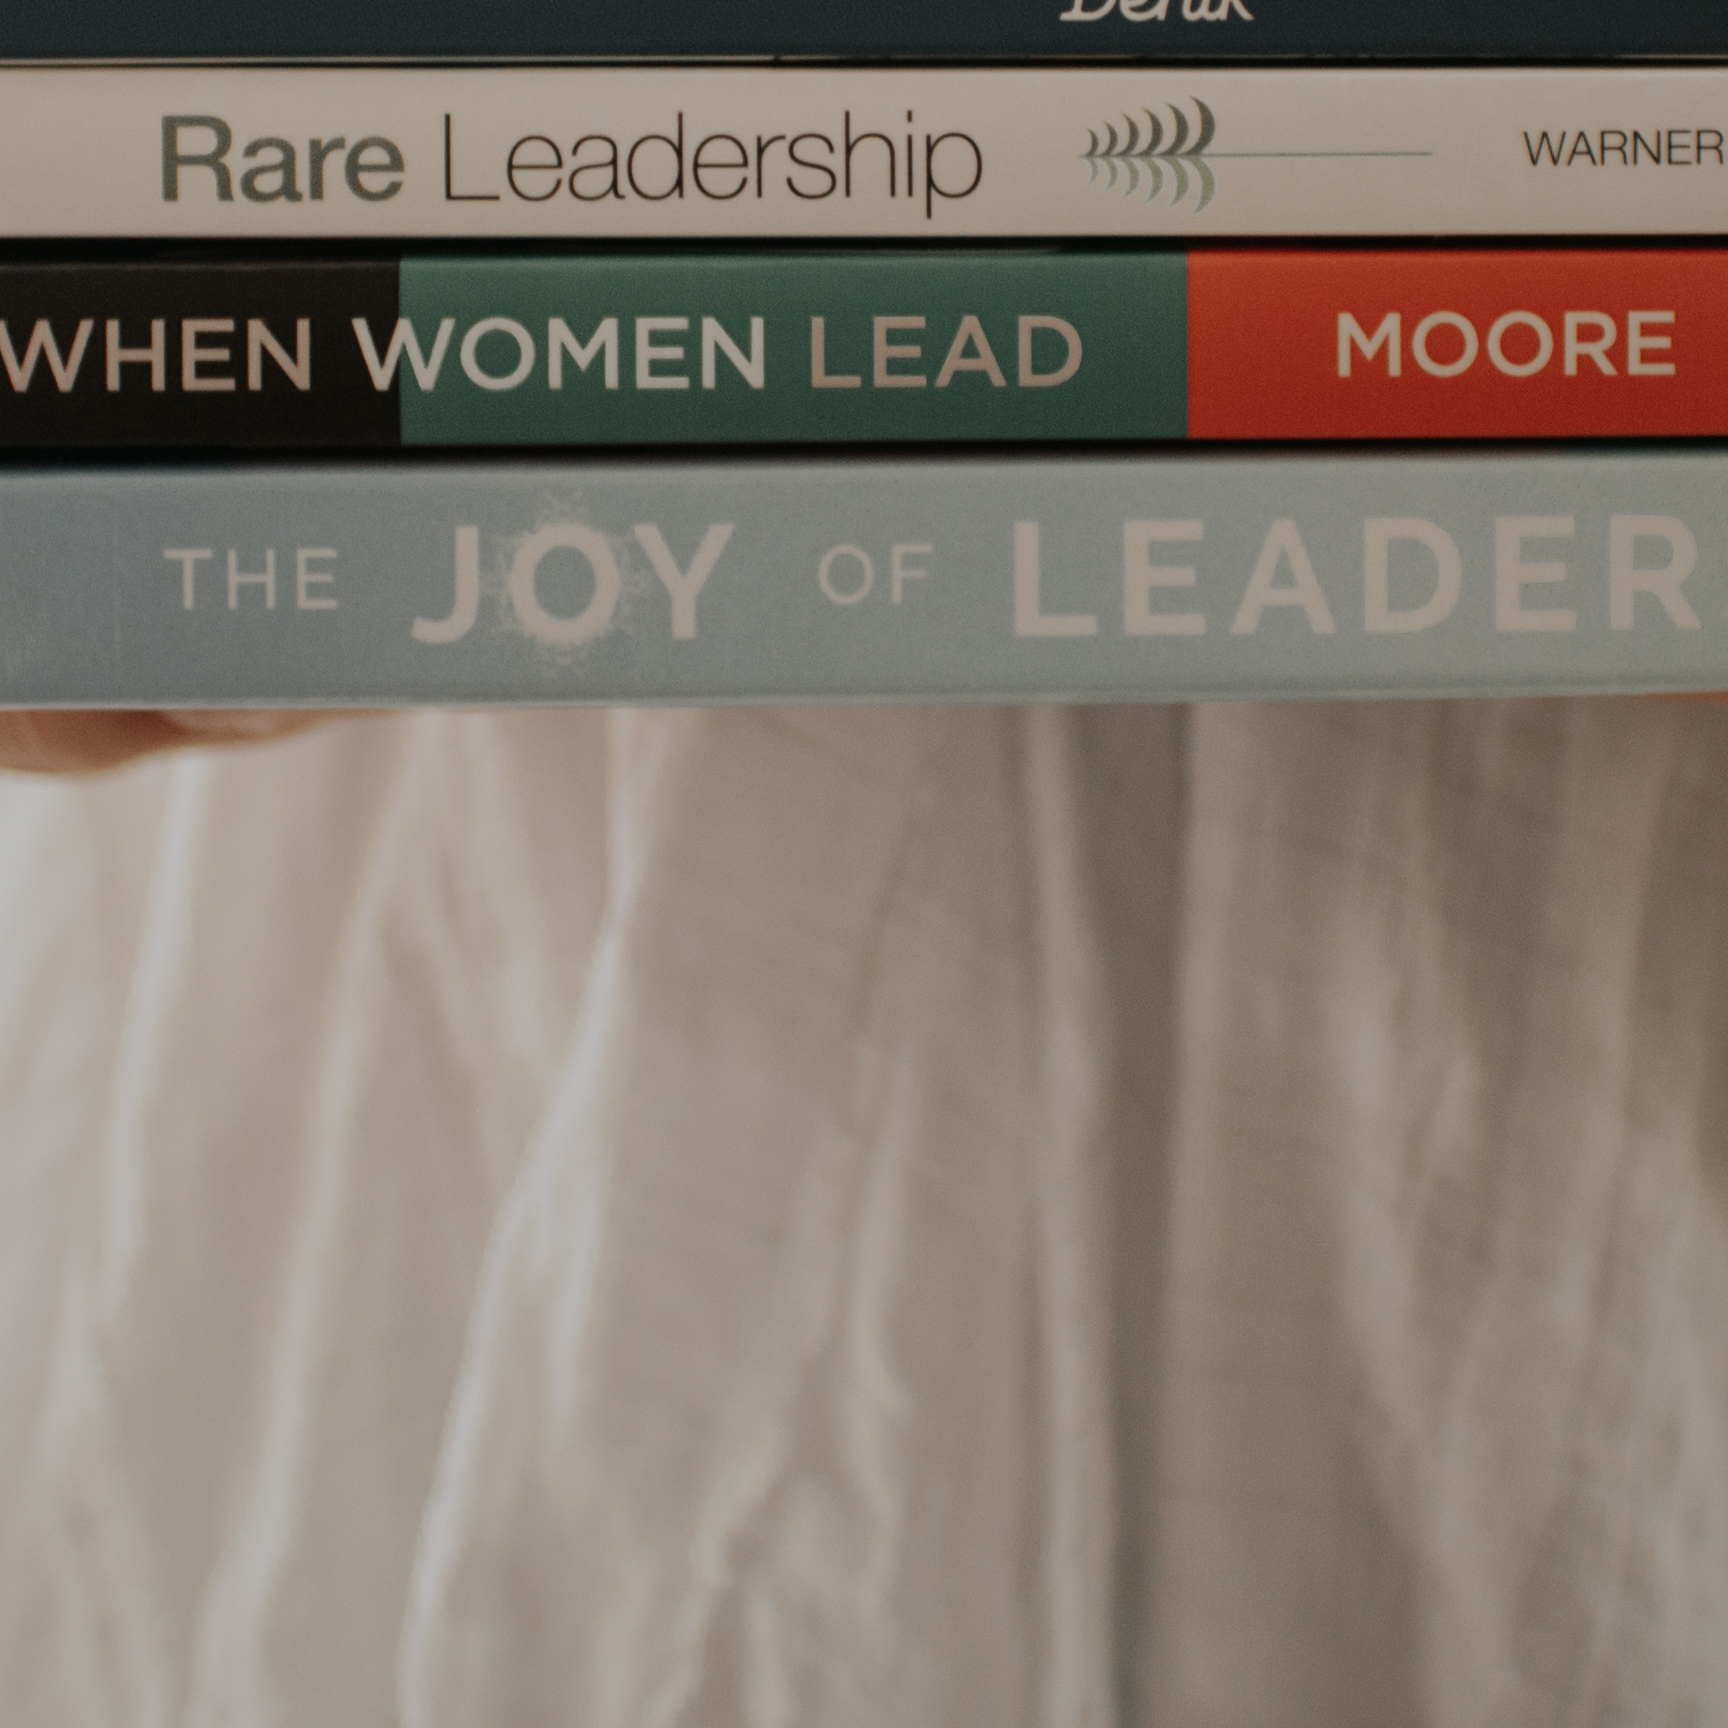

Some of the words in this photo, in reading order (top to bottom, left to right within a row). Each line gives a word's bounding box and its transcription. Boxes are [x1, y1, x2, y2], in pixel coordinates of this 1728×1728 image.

[162, 115, 405, 204] Rare
[444, 110, 983, 220] Leadership
[1522, 128, 1725, 167] WARNER
[352, 316, 766, 391] WOMEN
[810, 314, 1084, 388] LEAD
[1337, 310, 1676, 378] MOORE
[163, 546, 340, 611] THE
[412, 520, 734, 643] JOY
[817, 542, 933, 606] OF
